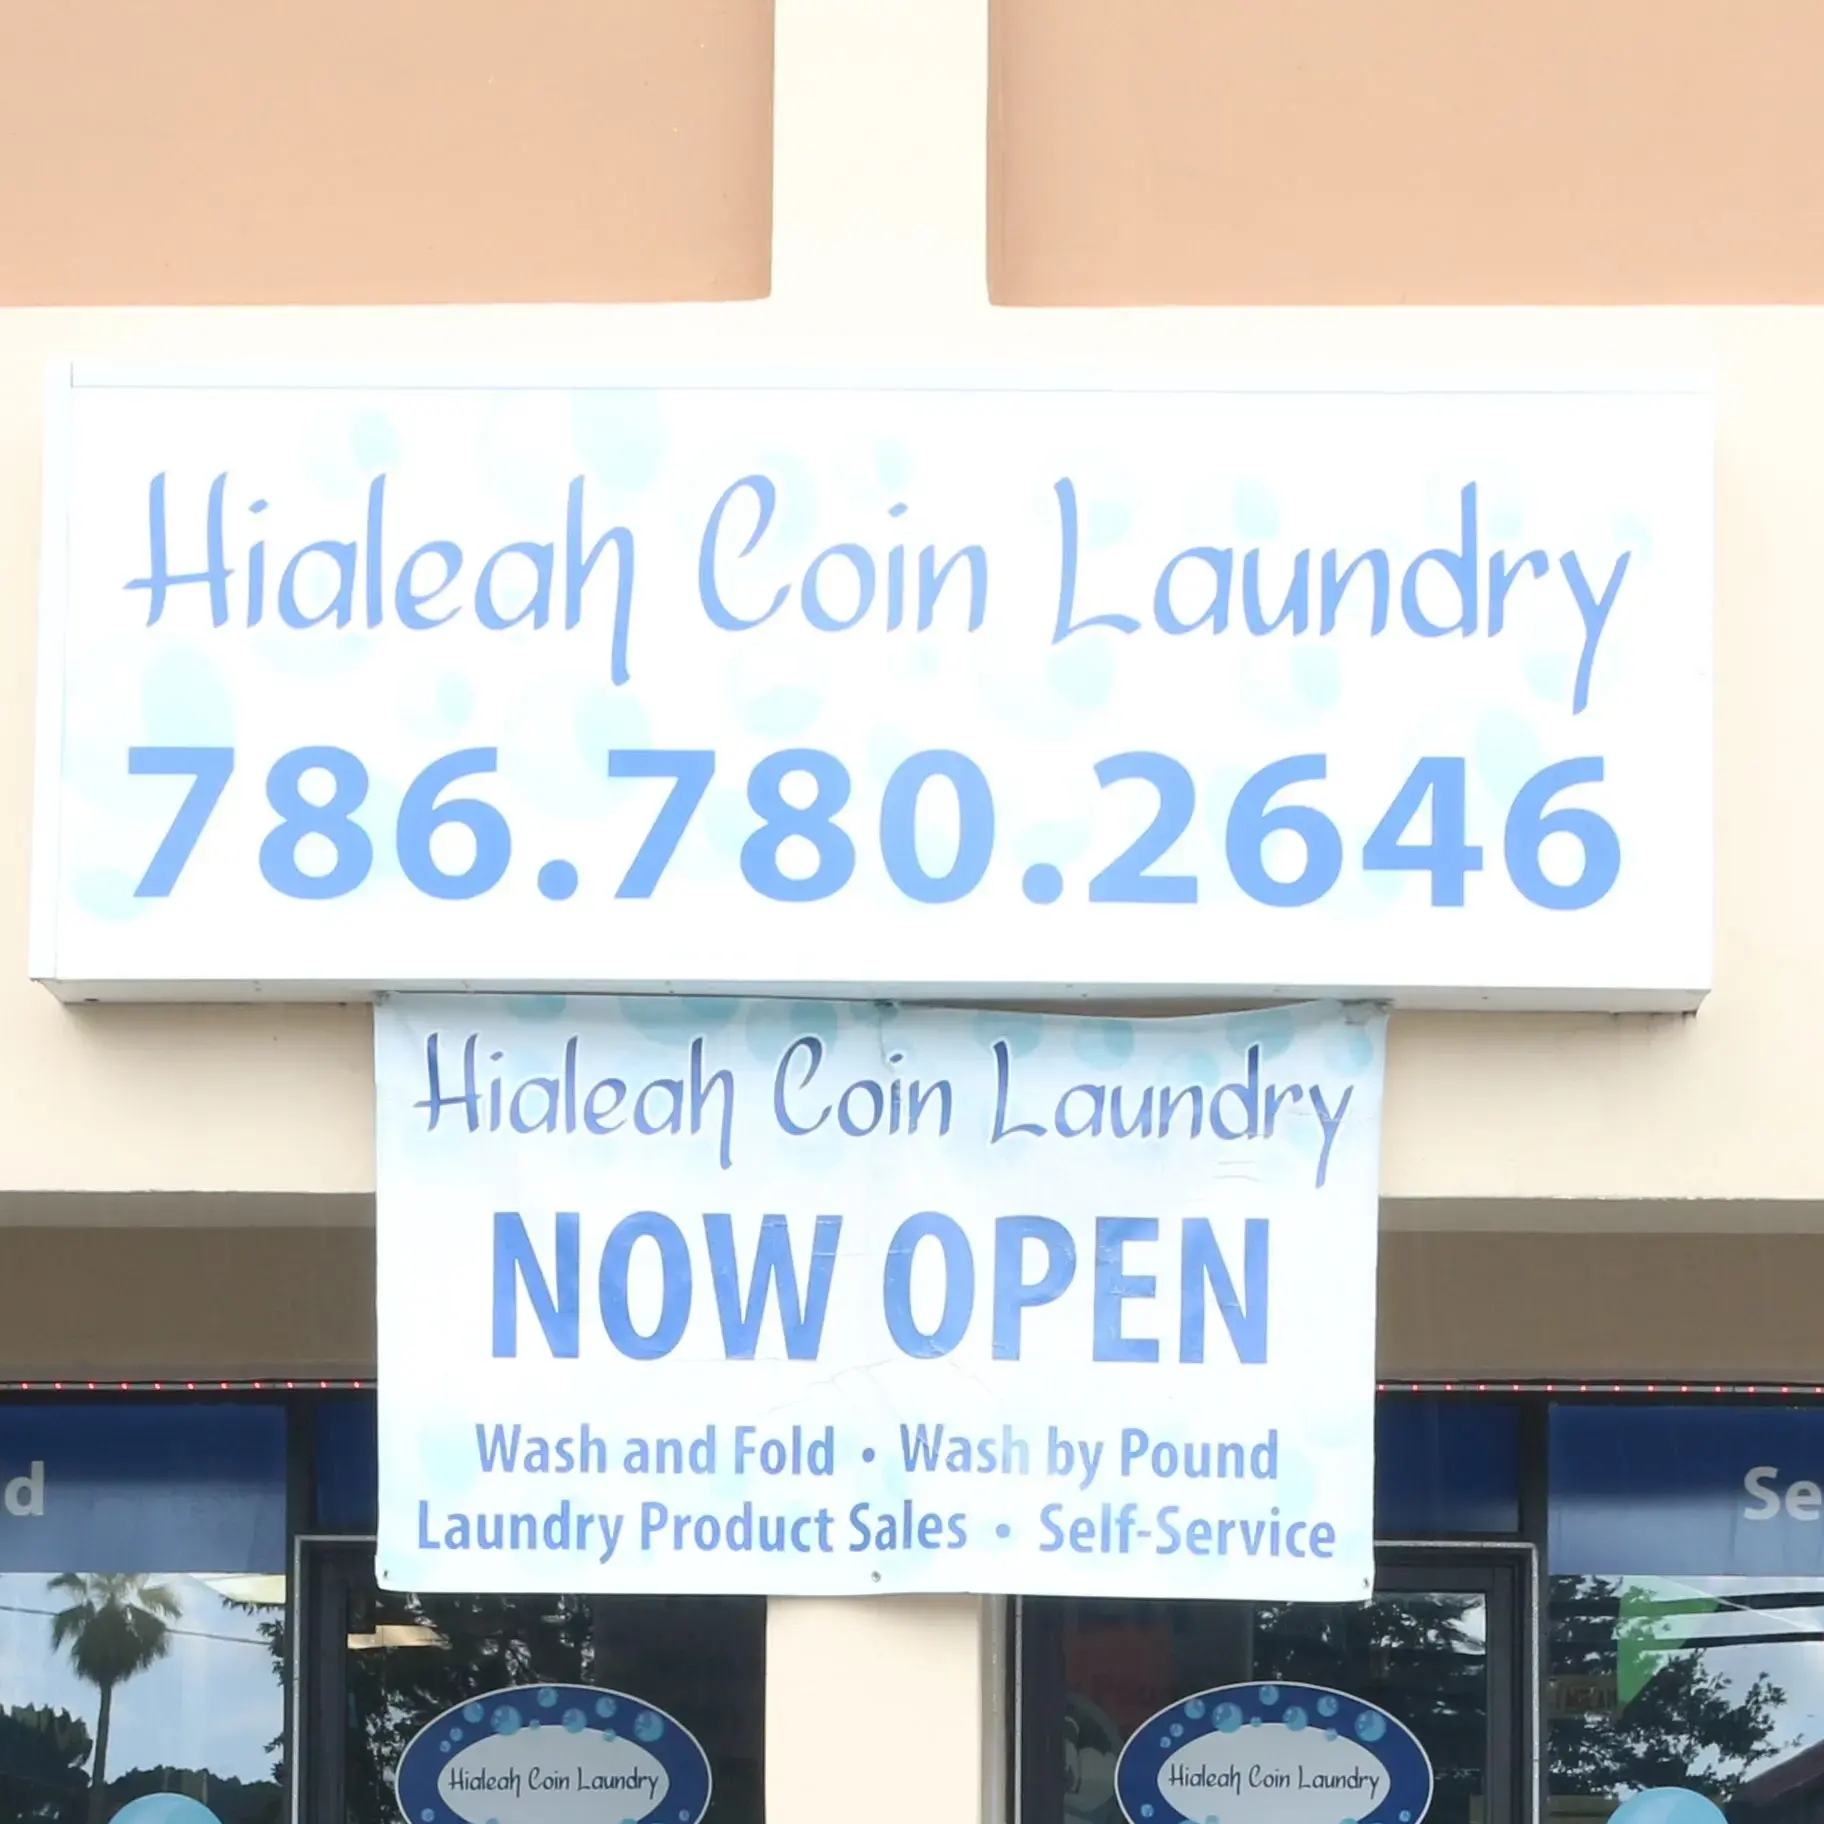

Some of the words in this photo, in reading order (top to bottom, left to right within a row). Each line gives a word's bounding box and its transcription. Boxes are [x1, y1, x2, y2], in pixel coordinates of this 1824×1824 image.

[124, 471, 634, 686] Hialeah
[696, 472, 989, 635] Coin
[1052, 476, 1631, 714] Laundry
[126, 745, 1623, 911] 786.780.2646
[412, 1032, 735, 1171] Hialeah
[772, 1035, 953, 1138] Coin
[989, 1040, 1354, 1189] Laundry
[491, 1211, 843, 1361] NOW
[882, 1210, 1269, 1364] OPEN
[475, 1423, 608, 1475] Wash
[622, 1423, 712, 1475] and
[733, 1425, 835, 1477] Fold
[899, 1423, 1030, 1477] Wash
[1044, 1427, 1106, 1489] by
[1119, 1428, 1278, 1480] Pound
[418, 1500, 624, 1564] Laundry
[640, 1500, 833, 1554] Product
[848, 1498, 967, 1551] Sales
[1039, 1502, 1335, 1559] Self-Service
[448, 1768, 521, 1798] Hialeah
[527, 1766, 570, 1791] Coin
[576, 1767, 659, 1799] Laundry
[1168, 1763, 1241, 1795] Hialeah
[1248, 1765, 1290, 1789] Coin
[1297, 1765, 1380, 1799] Laundry
